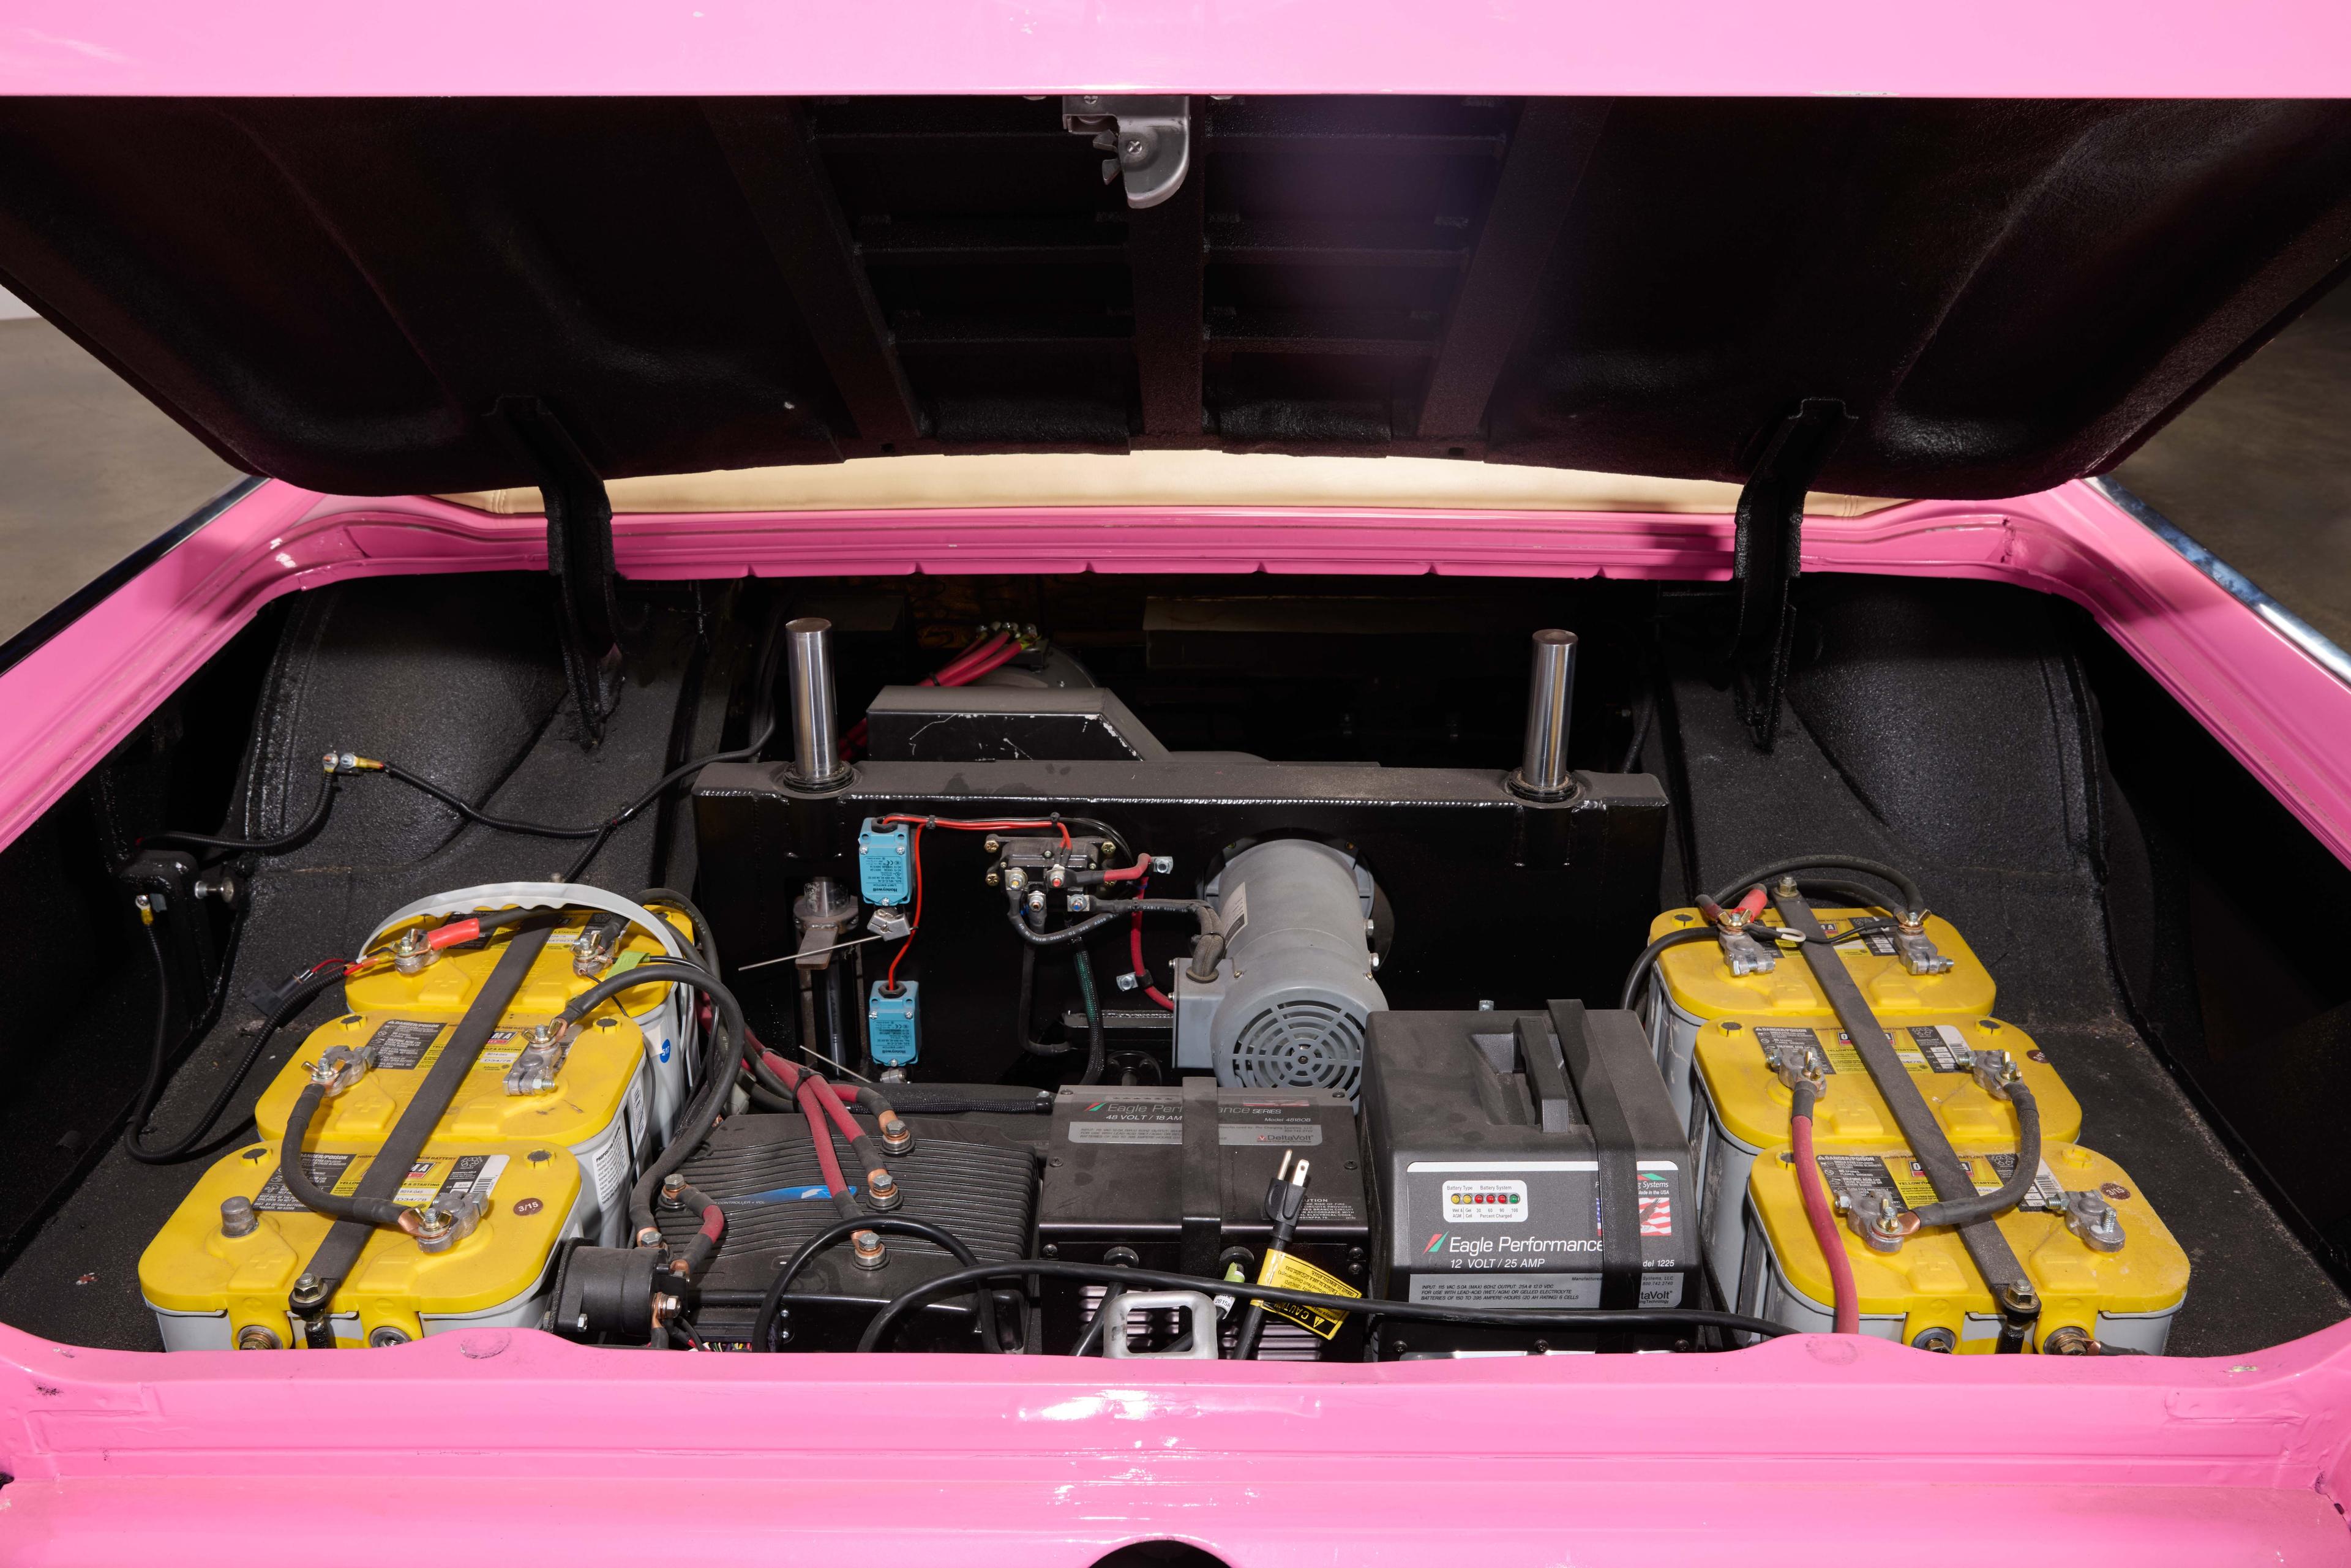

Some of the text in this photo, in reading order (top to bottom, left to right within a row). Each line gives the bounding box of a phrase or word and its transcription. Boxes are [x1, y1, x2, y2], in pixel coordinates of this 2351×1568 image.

[1108, 1103, 1147, 1114] Eagle
[2105, 1187, 2125, 1195] 3/15
[518, 1201, 539, 1212] 3/15
[1449, 1236, 1603, 1256] Eagle Performance
[1450, 1258, 1545, 1268] 12 VOLT / 25 AMP
[1322, 1277, 1337, 1287] electric
[1323, 1284, 1338, 1295] Failure
[1341, 1288, 1354, 1296] result
[1640, 1291, 1669, 1299] taVolt
[1322, 1311, 1336, 1321] Always
